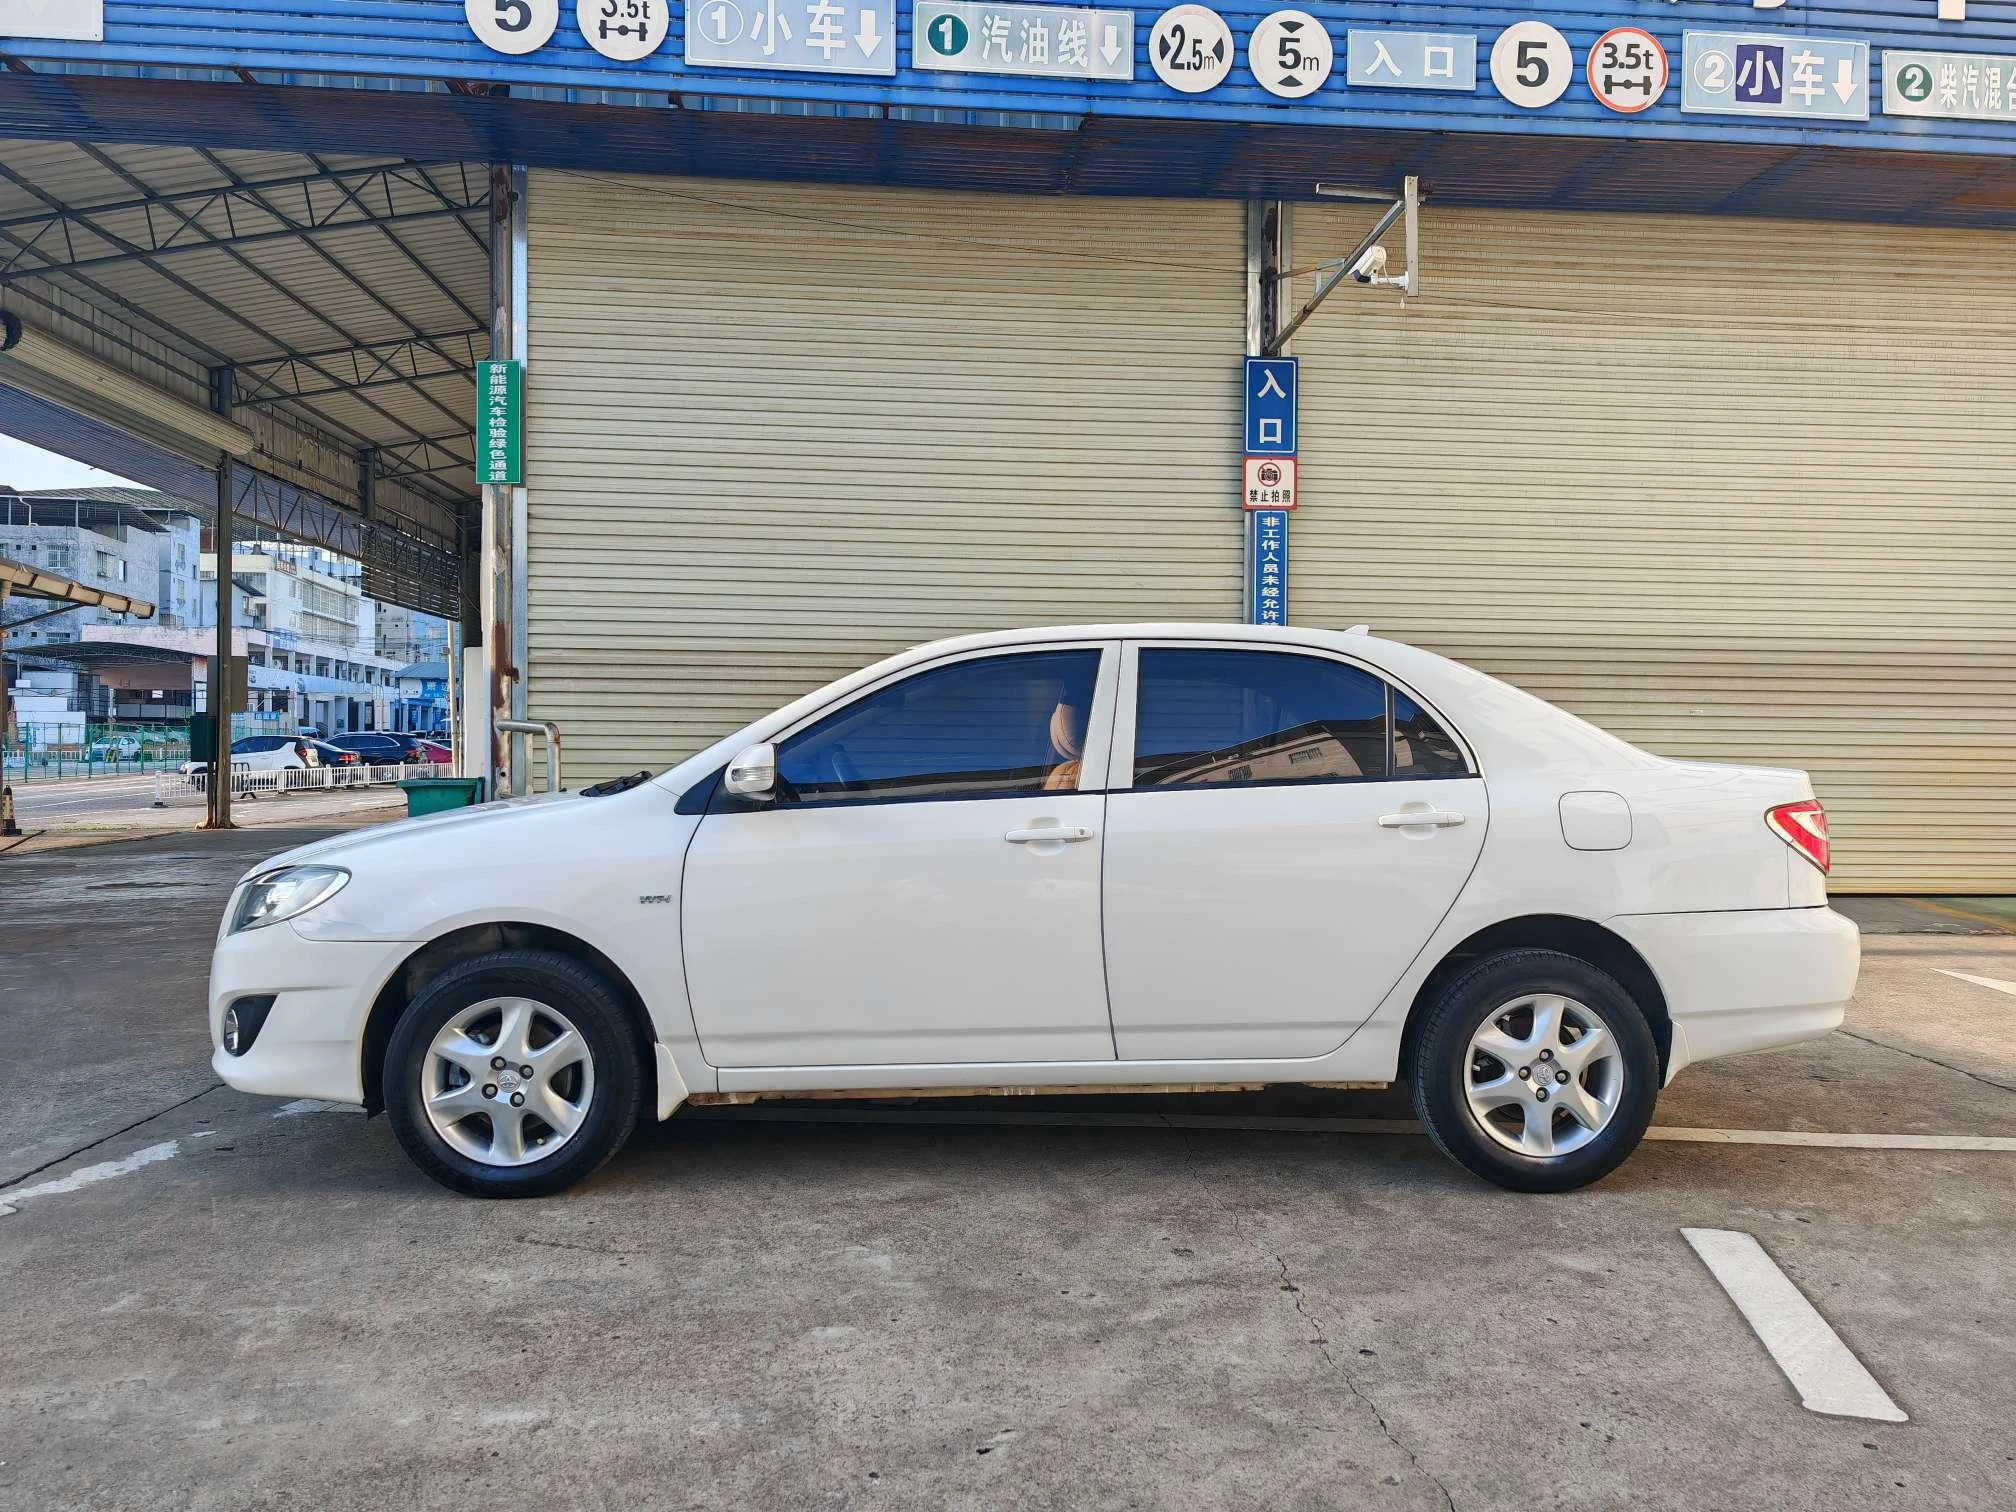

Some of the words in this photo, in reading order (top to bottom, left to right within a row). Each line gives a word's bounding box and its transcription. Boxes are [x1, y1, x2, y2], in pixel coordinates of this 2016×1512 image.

[494, 0, 532, 32] 5
[1170, 24, 1216, 72] 2.5m
[1277, 37, 1320, 72] 5m
[1364, 39, 1455, 78] 入口
[1516, 40, 1550, 88] 5
[1602, 43, 1654, 69] 3.5t
[488, 363, 508, 481] 新能源汽车检验绿色通道
[1257, 368, 1287, 444] 入口
[1249, 489, 1291, 503] 禁止拍照
